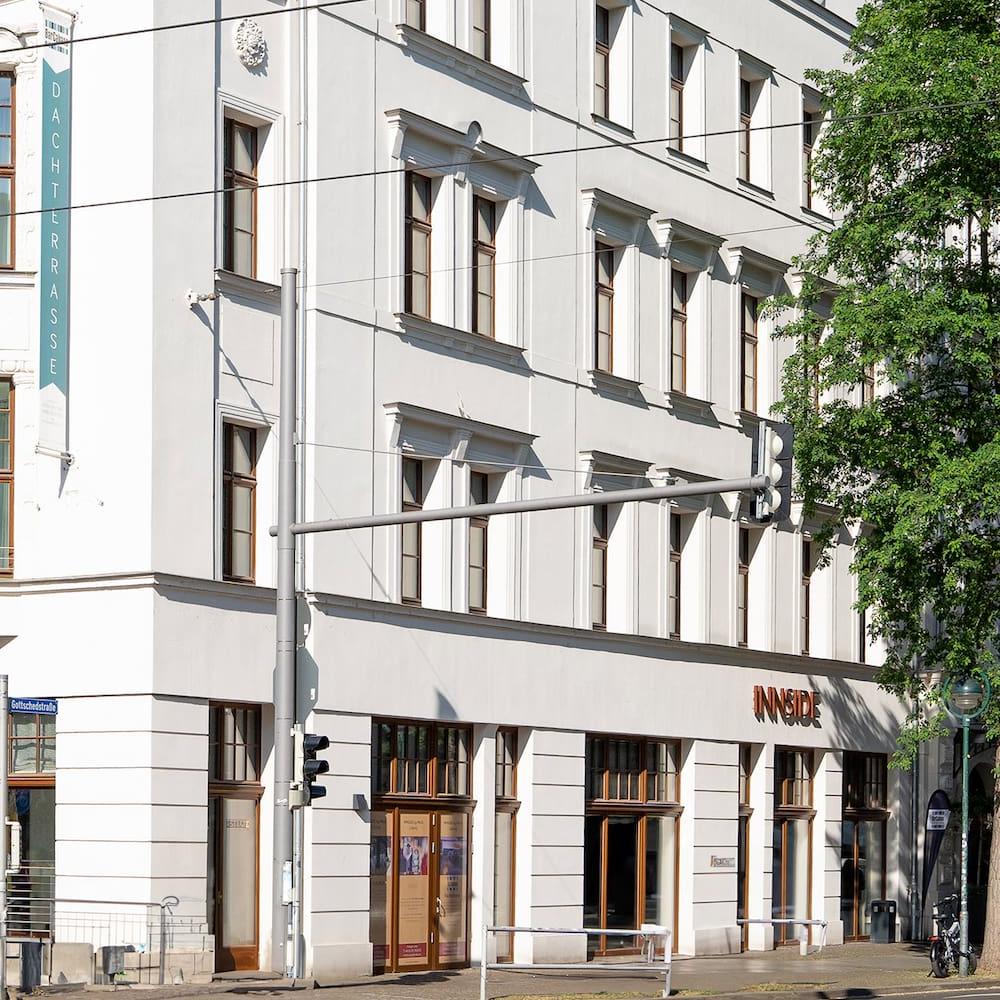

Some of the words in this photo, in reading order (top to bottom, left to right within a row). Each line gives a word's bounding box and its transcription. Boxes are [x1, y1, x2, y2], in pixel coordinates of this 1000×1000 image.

[50, 81, 61, 375] DACHTERRASSE
[11, 699, 56, 712] Gottschedstraße
[753, 685, 820, 720] INNSIDE
